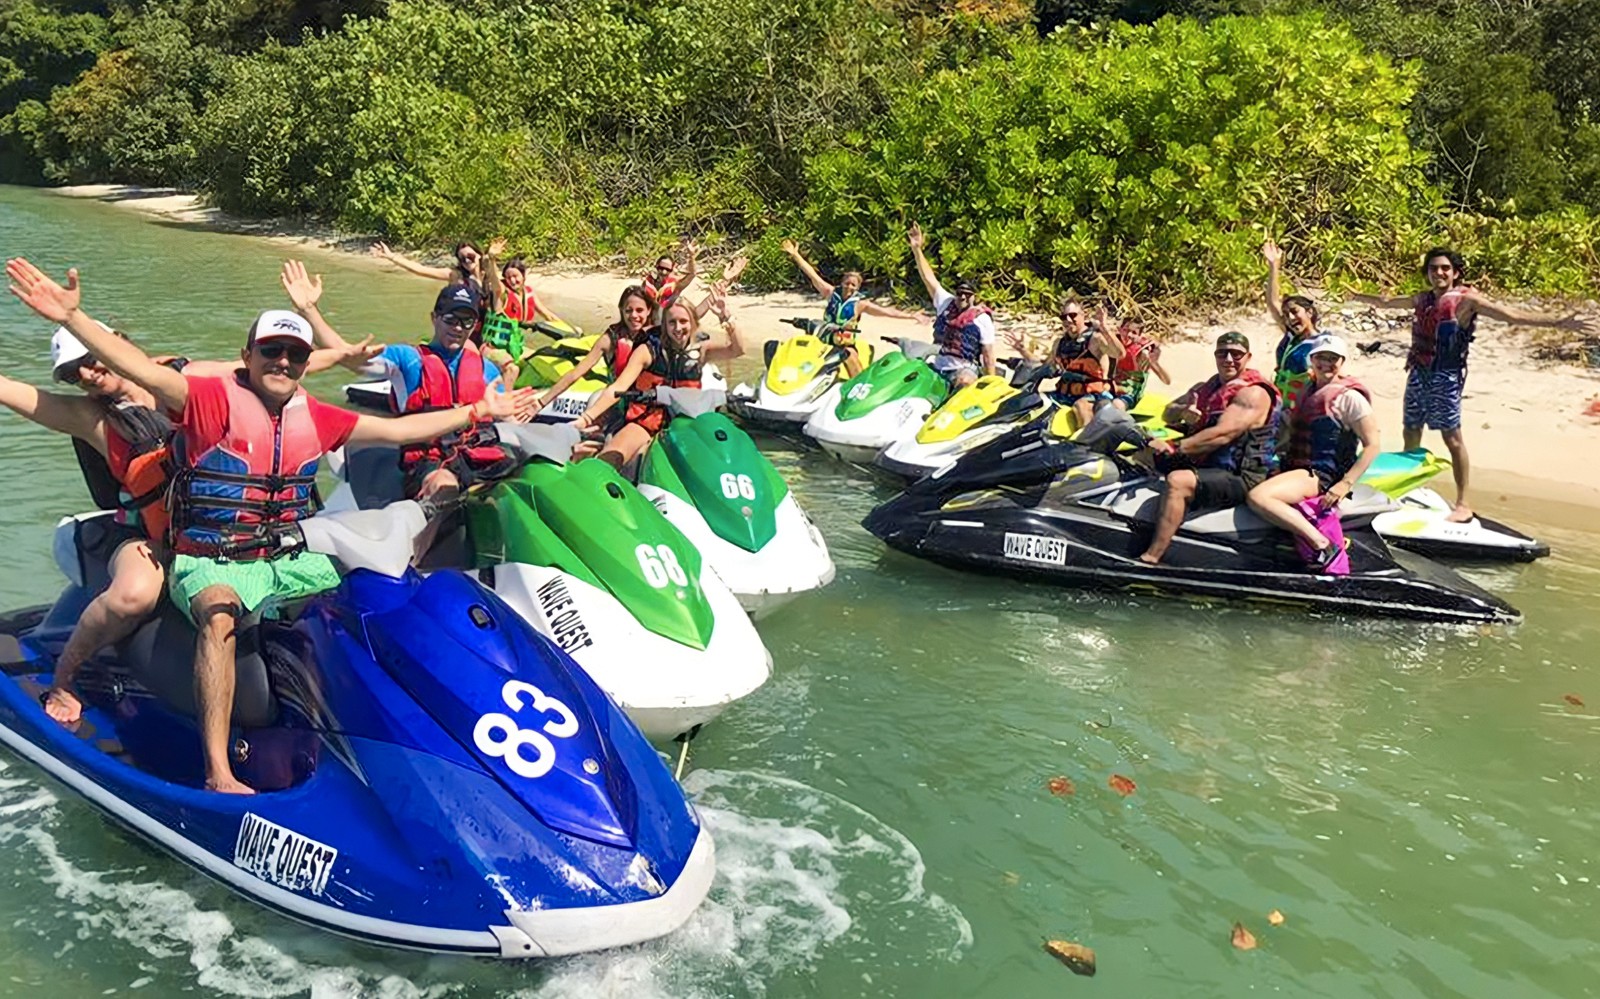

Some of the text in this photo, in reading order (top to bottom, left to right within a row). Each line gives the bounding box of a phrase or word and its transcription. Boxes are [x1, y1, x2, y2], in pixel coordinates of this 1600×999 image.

[570, 399, 588, 416] QUES
[847, 382, 874, 400] 65
[720, 472, 756, 501] 66
[635, 544, 688, 589] 68
[1006, 536, 1065, 562] WAVE QUEST
[536, 575, 593, 655] WAVE QUEST
[473, 679, 579, 778] 83
[237, 814, 335, 894] WAVE QUEST
